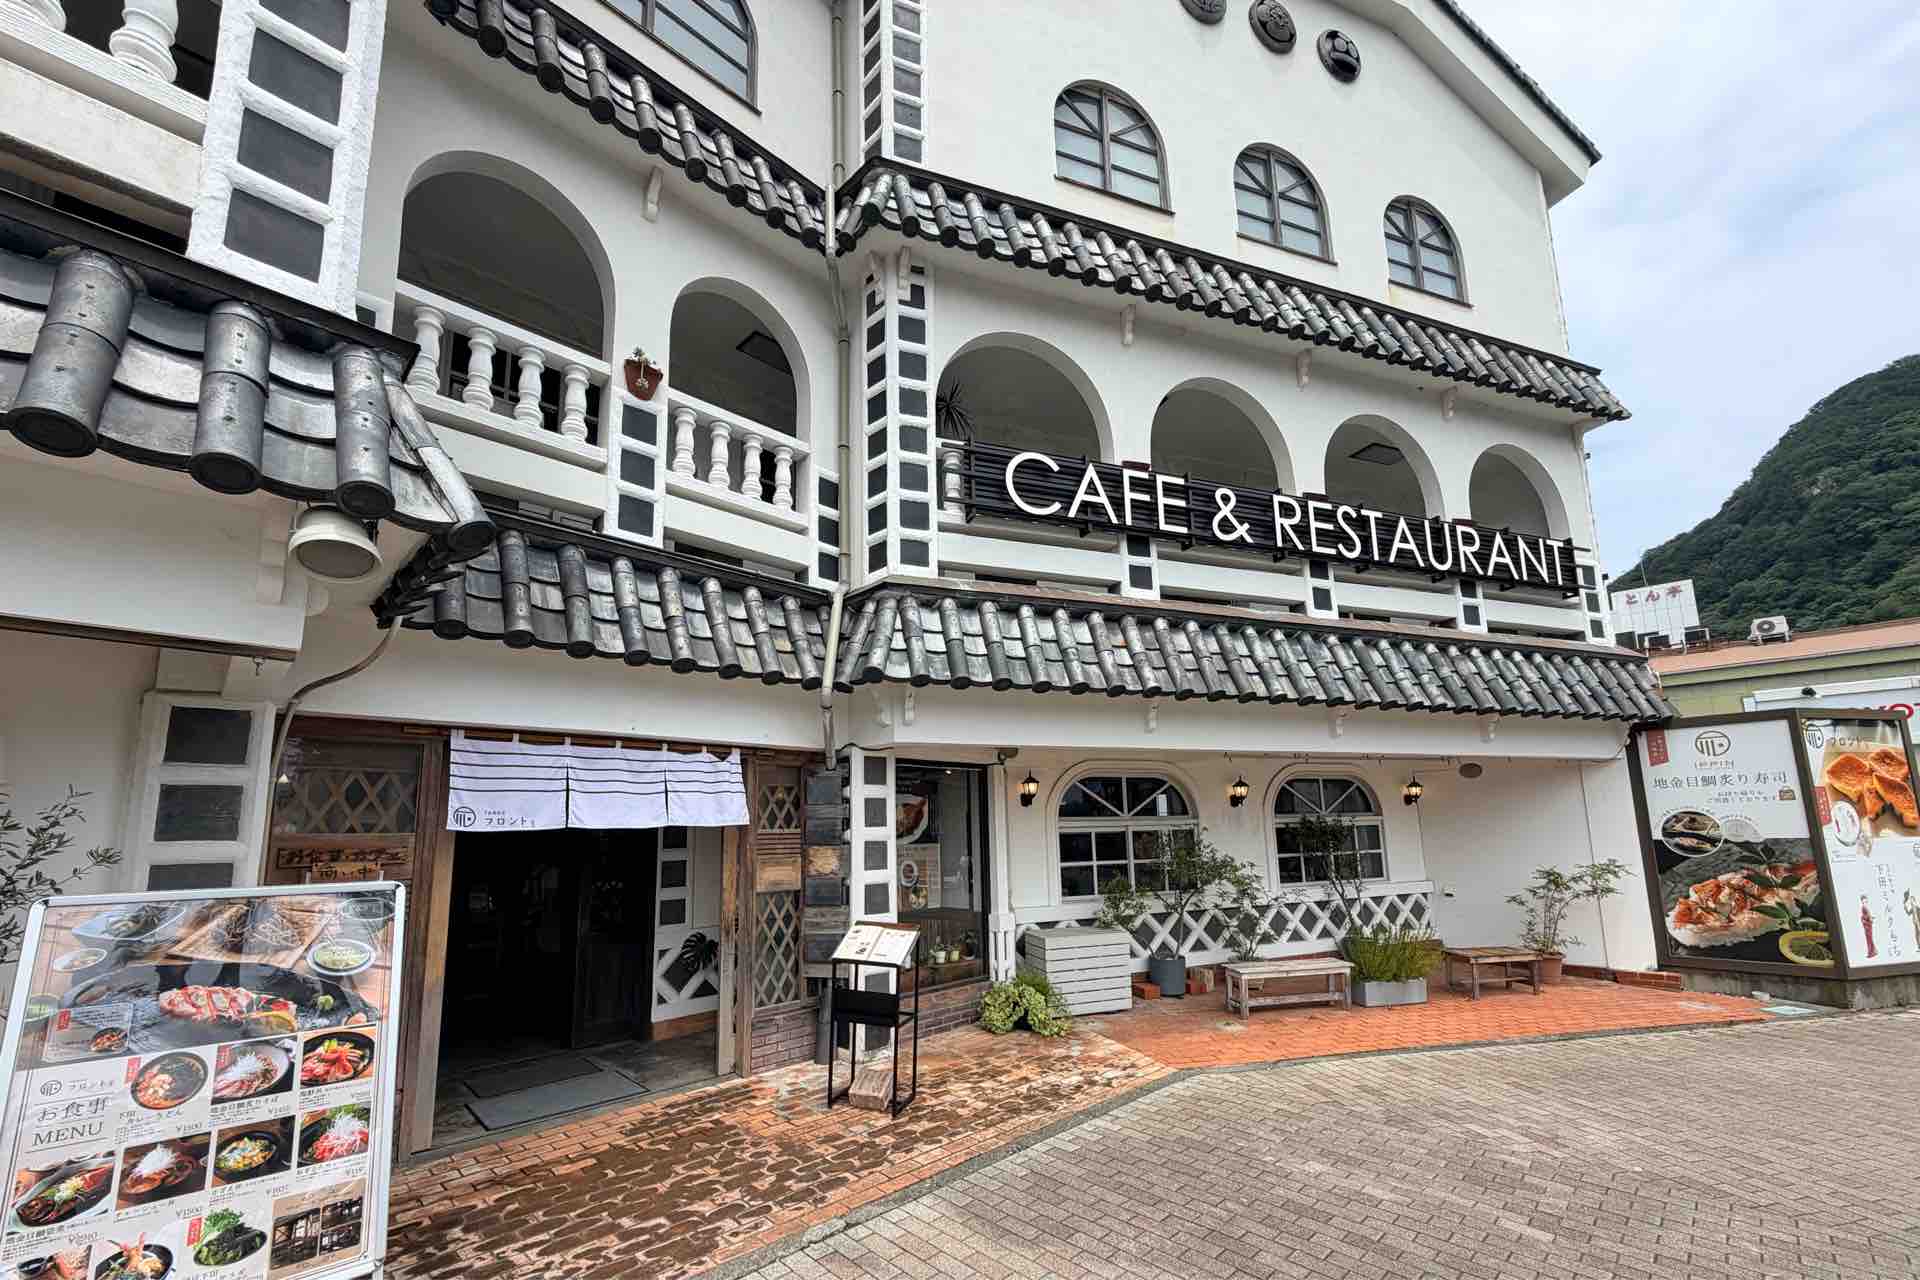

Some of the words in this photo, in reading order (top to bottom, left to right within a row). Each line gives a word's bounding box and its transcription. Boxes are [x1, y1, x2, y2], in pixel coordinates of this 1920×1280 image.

[1005, 452, 1189, 532] CAFE
[1211, 487, 1254, 543] &
[1273, 495, 1566, 585] RESTAURANT
[1653, 771, 1788, 790] 地金目鯛炙り寿司
[484, 816, 528, 826] フロント
[37, 1096, 110, 1123] お食事
[32, 1121, 104, 1147] MENU
